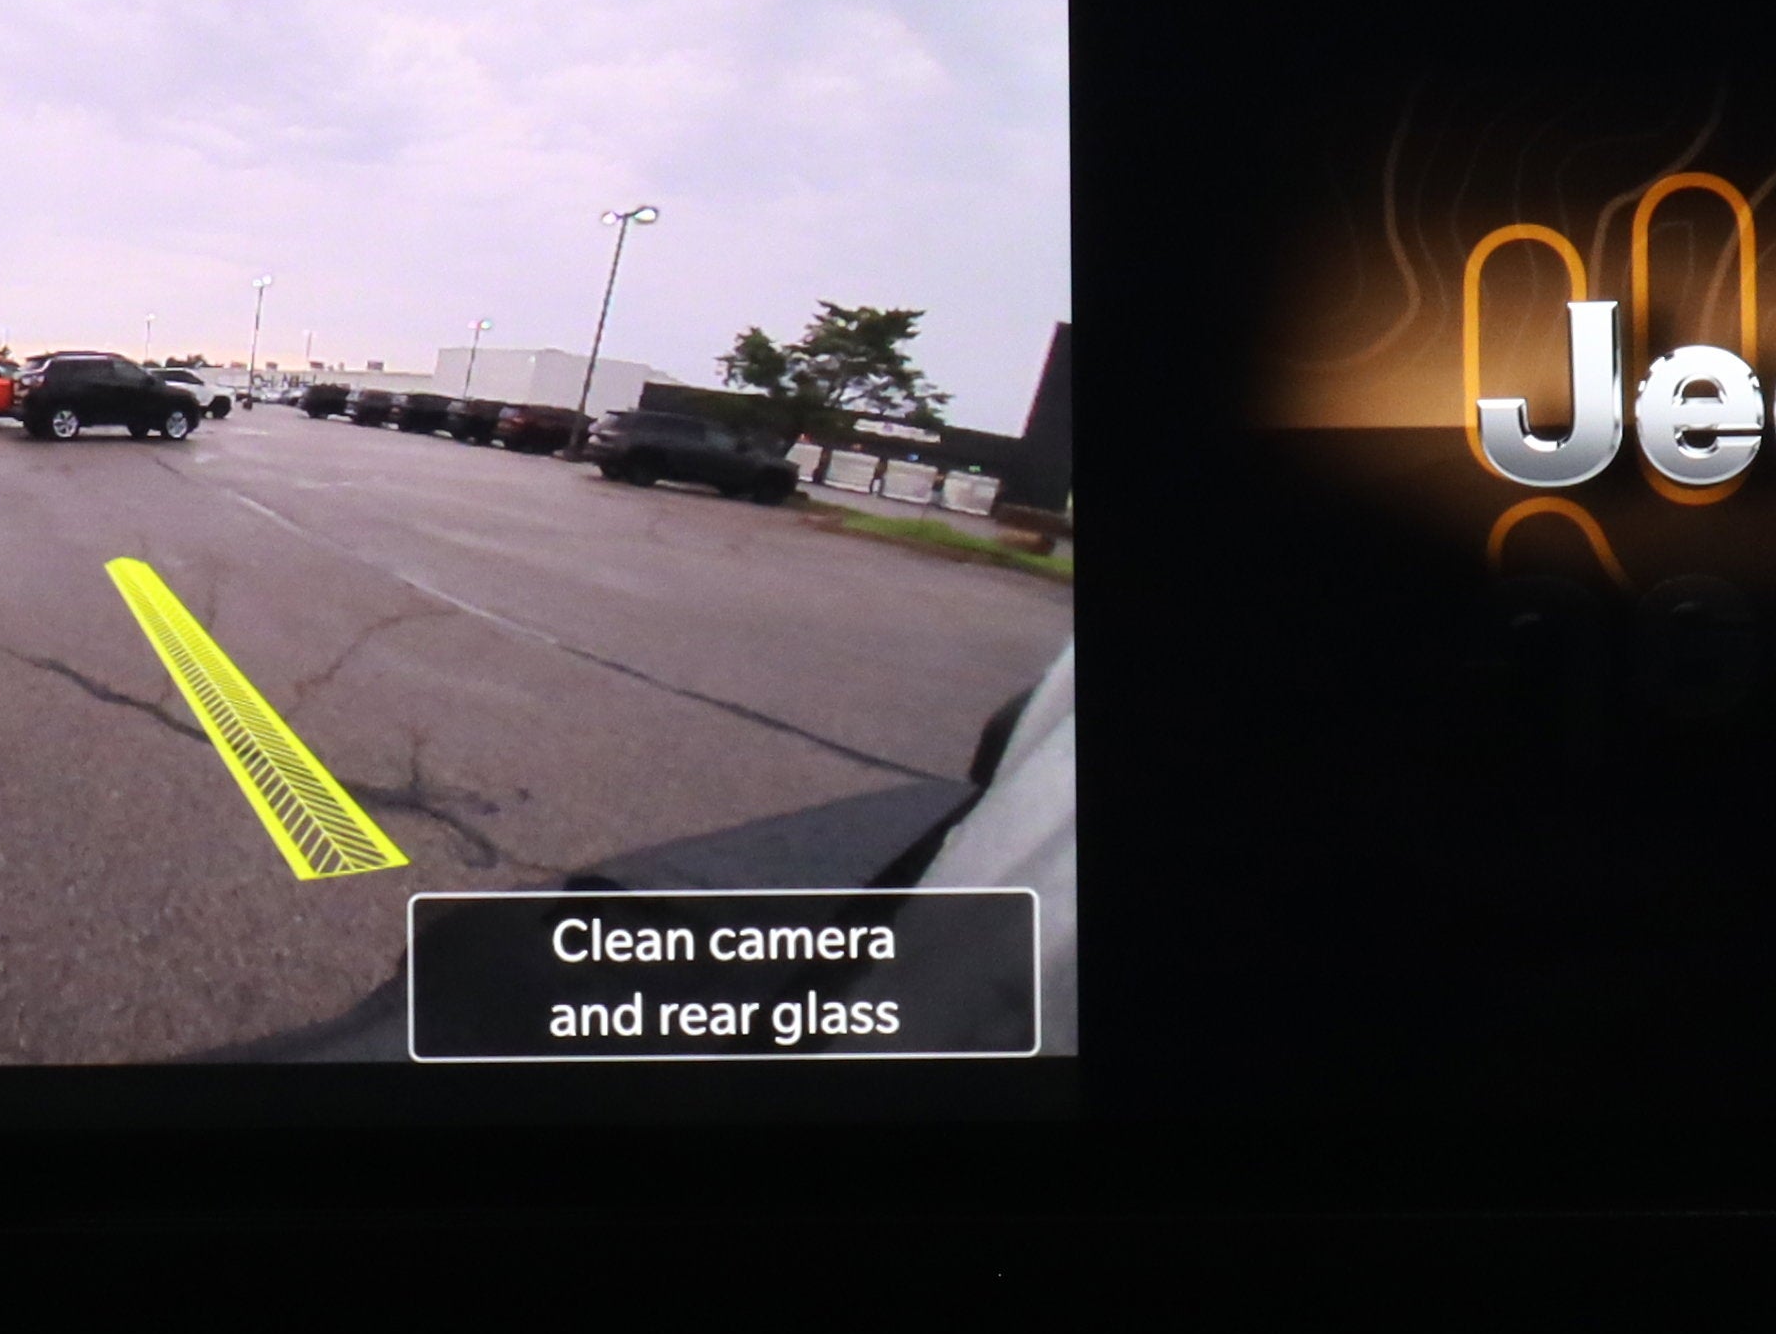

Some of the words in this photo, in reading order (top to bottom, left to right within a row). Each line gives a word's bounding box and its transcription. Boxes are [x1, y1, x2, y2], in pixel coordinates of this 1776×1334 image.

[552, 918, 694, 963] Clean
[709, 926, 895, 961] camera
[549, 991, 643, 1037] and
[660, 1002, 760, 1036] rear
[772, 990, 900, 1046] glass
